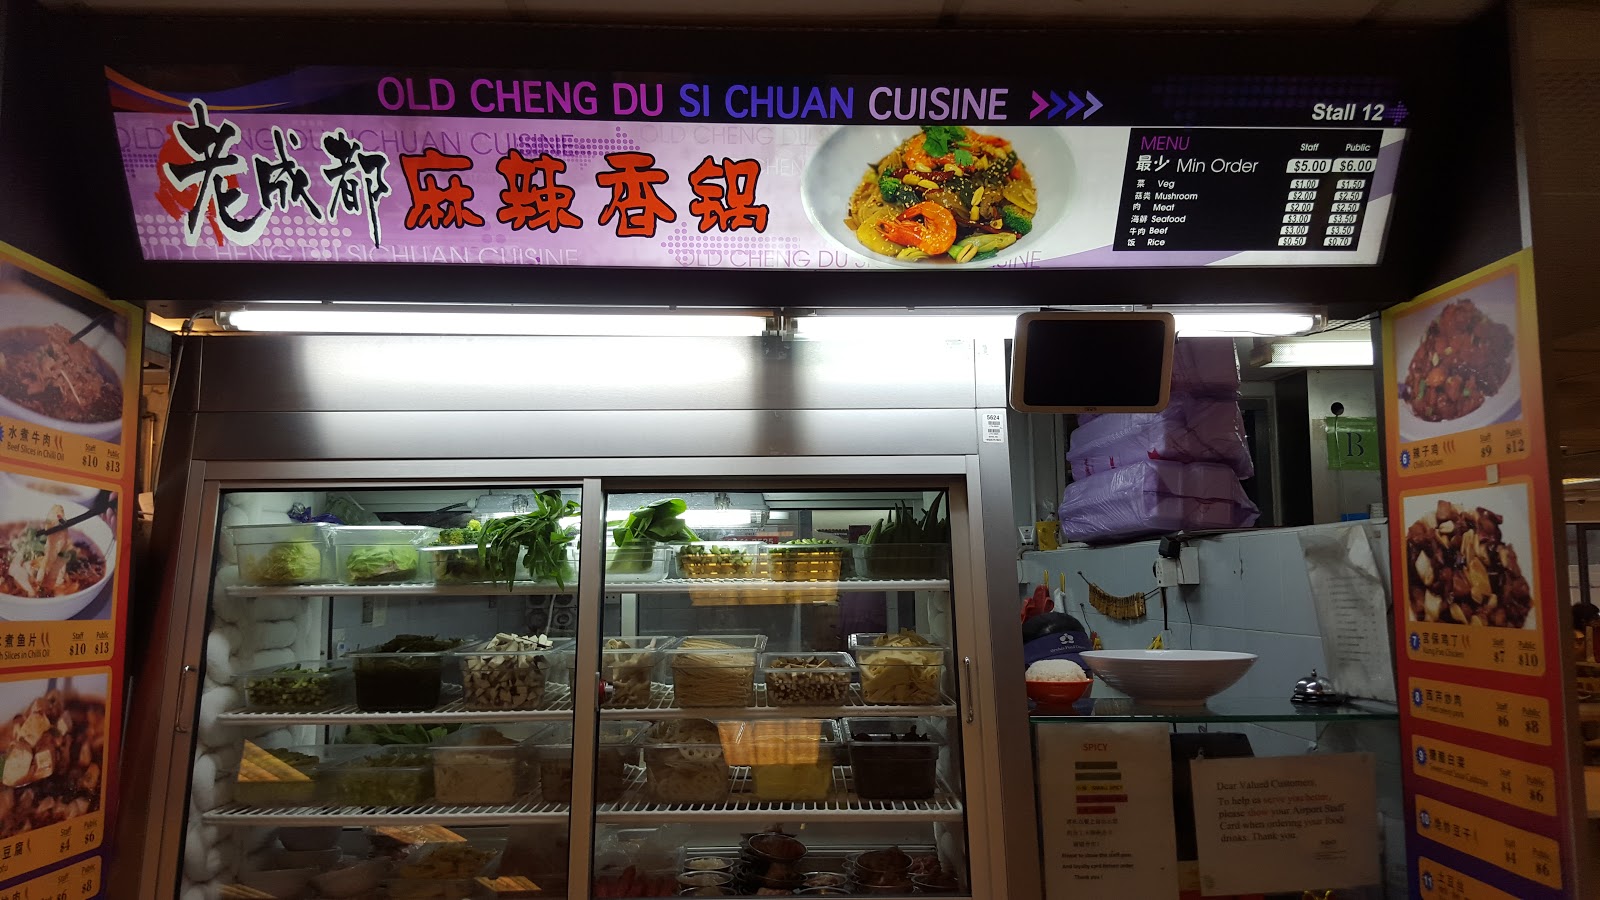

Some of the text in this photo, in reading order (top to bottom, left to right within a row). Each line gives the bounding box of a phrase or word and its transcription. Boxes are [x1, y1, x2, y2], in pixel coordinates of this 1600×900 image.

[377, 76, 1009, 121] OLD CHENG DU SI CHUAN CUISINE
[1311, 103, 1385, 121] Stall 12
[1140, 136, 1190, 151] MENU
[1300, 142, 1371, 152] Staff Public
[1135, 154, 1259, 173] 最少 Min Order
[1293, 160, 1372, 172] $5.00 $6.00
[163, 98, 769, 249] 老成都 麻辣香锅
[1157, 180, 1175, 190] Veg
[1294, 179, 1362, 189] $1.00 $1.50
[1154, 192, 1198, 200] Mushroom
[1292, 191, 1360, 201] $2.00 $2.50
[1132, 202, 1175, 212] 肉 Meat
[1290, 203, 1357, 212] $2.00 $2.50
[1151, 215, 1186, 223] Seafood
[1287, 214, 1354, 223] $3.00 $3.50
[1129, 227, 1168, 235] 牛肉 Beef
[1284, 226, 1351, 235] $3.00 $3.50
[1147, 238, 1165, 246] Rice
[1282, 237, 1349, 246] $0.50 $0.70
[8, 425, 51, 448] 水煮牛肉
[7, 442, 20, 453] Beef
[20, 444, 36, 456] Slices
[37, 448, 43, 456] in
[85, 443, 96, 453] Staff
[1346, 432, 1365, 457] B
[1480, 439, 1525, 458] $9 $12
[82, 455, 120, 473] $10 $13
[1402, 453, 1407, 465] 6
[72, 631, 109, 640] Staff Public
[1412, 636, 1417, 647] 7
[69, 642, 109, 656] $10 $13
[4, 650, 20, 660] Slices
[1518, 653, 1538, 667] $10
[1525, 720, 1539, 733] $8
[1083, 743, 1108, 751] SPICY
[1216, 782, 1237, 791] Dear
[1239, 780, 1269, 790] Valued
[1217, 797, 1230, 806] To
[1231, 796, 1250, 806] help
[1218, 809, 1245, 819] please
[1271, 808, 1290, 818] your
[1292, 806, 1323, 816] Airport
[1324, 803, 1345, 813] Staff
[1219, 821, 1241, 831] Card
[1242, 821, 1264, 829] when
[1266, 818, 1302, 830] ordering
[1303, 818, 1323, 829] your
[59, 830, 95, 853] $4 $6
[1252, 832, 1277, 842] Thank
[2, 841, 24, 860] 豆腐
[81, 879, 92, 894] $8
